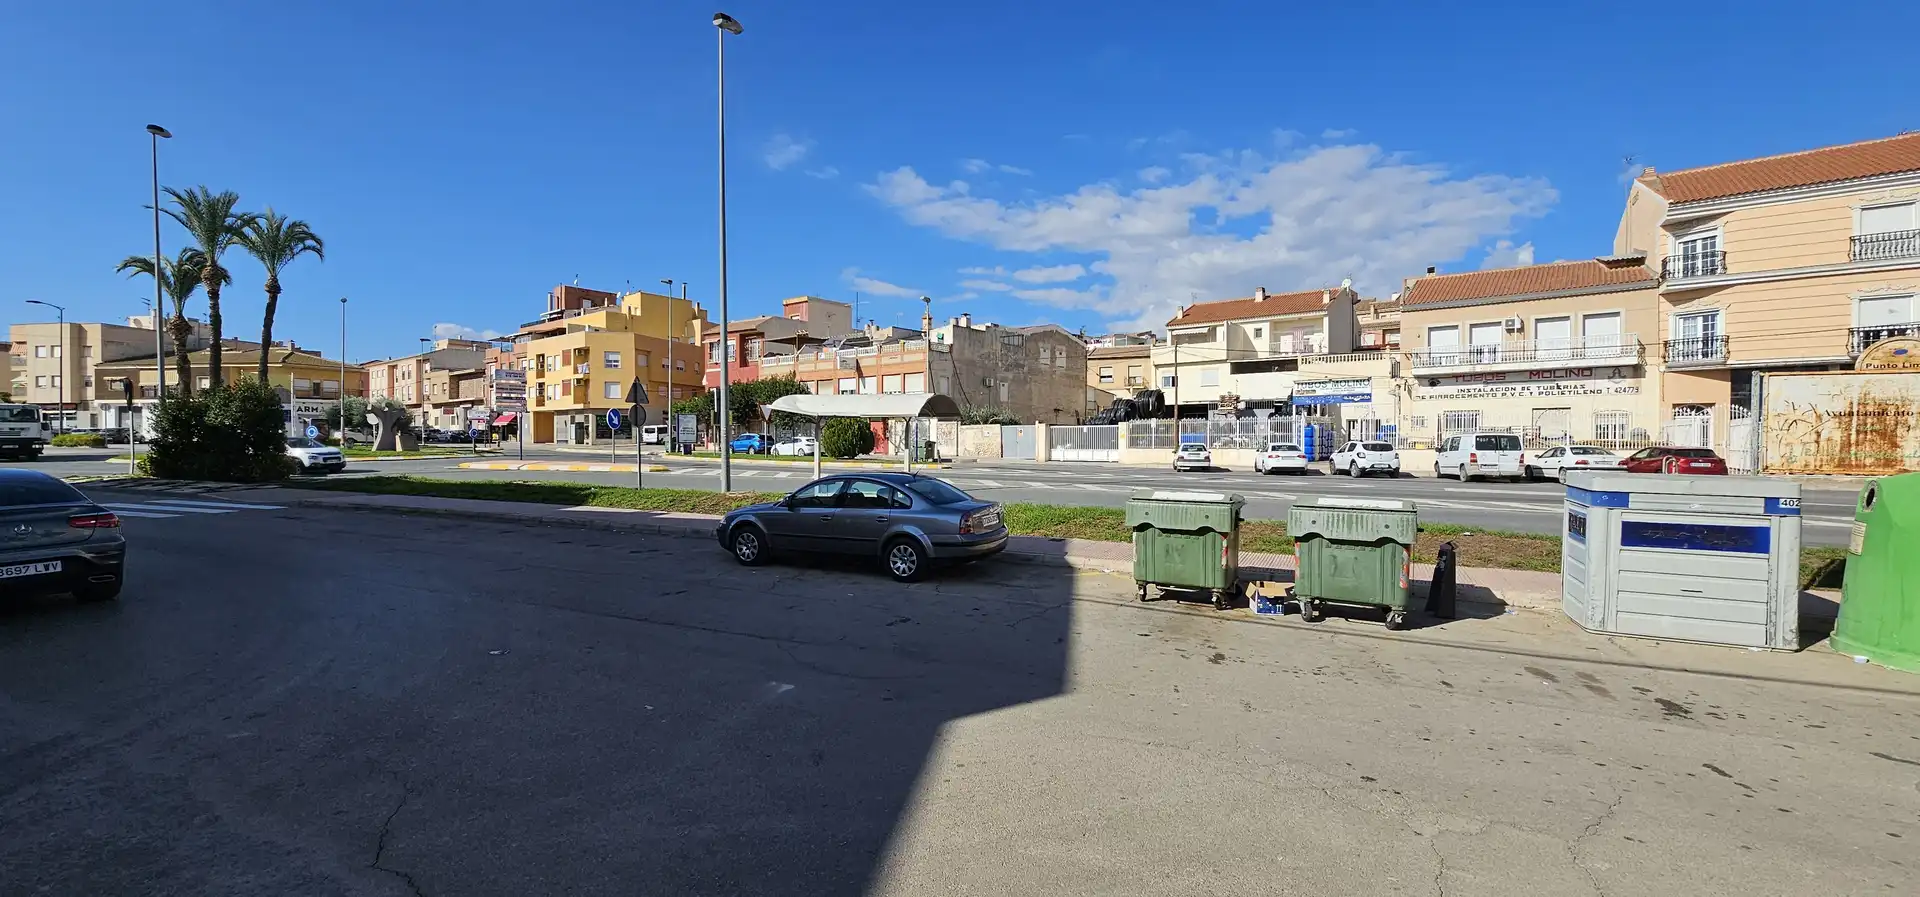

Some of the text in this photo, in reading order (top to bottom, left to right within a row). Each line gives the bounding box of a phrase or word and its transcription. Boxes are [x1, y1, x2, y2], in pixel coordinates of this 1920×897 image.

[1452, 367, 1593, 383] TUBOS MOLINO
[1331, 379, 1370, 388] MOLINO
[1457, 386, 1517, 394] INSTALACION
[1536, 382, 1586, 391] TUBERIAS
[1781, 499, 1800, 507] 402
[34, 562, 58, 573] LWV
